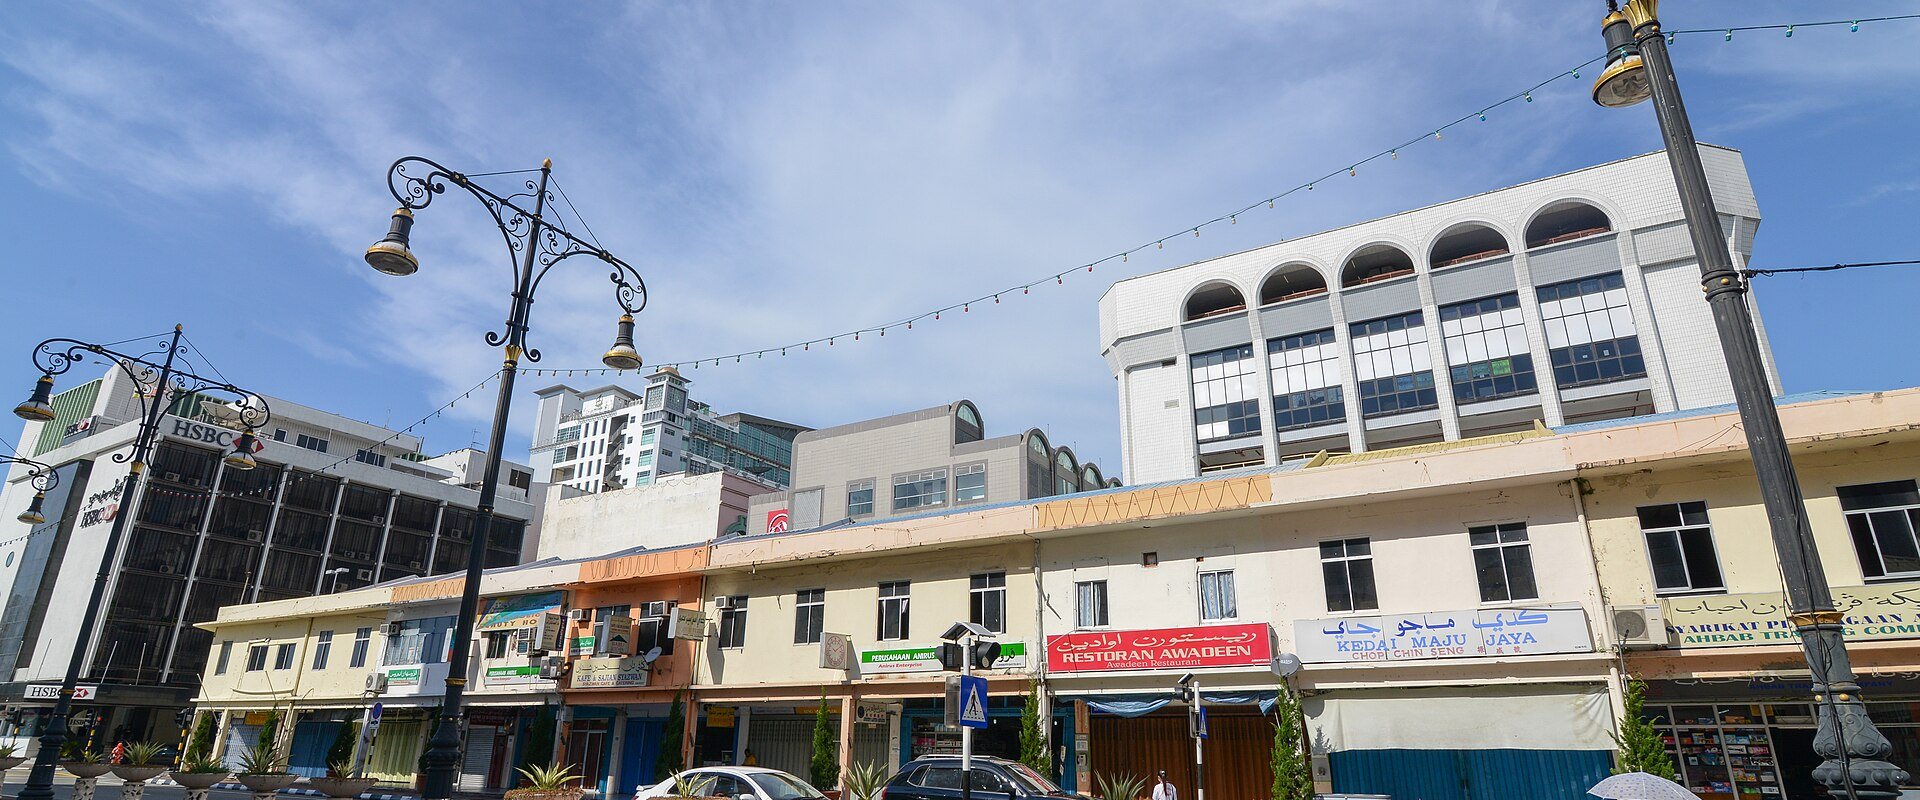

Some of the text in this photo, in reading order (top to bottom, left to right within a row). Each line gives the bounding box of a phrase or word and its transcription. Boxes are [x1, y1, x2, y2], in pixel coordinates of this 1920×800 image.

[172, 419, 233, 448] HSBC
[1337, 632, 1537, 652] KEDAI MAJU JAYA
[1684, 632, 1754, 643] AHBAB
[872, 653, 912, 662] PERUSAHAAN
[1063, 645, 1251, 663] RESTORAN AWADEEN
[1352, 647, 1464, 660] CHOP CHIN SENG
[1106, 658, 1201, 668] Awadeen Restaurant
